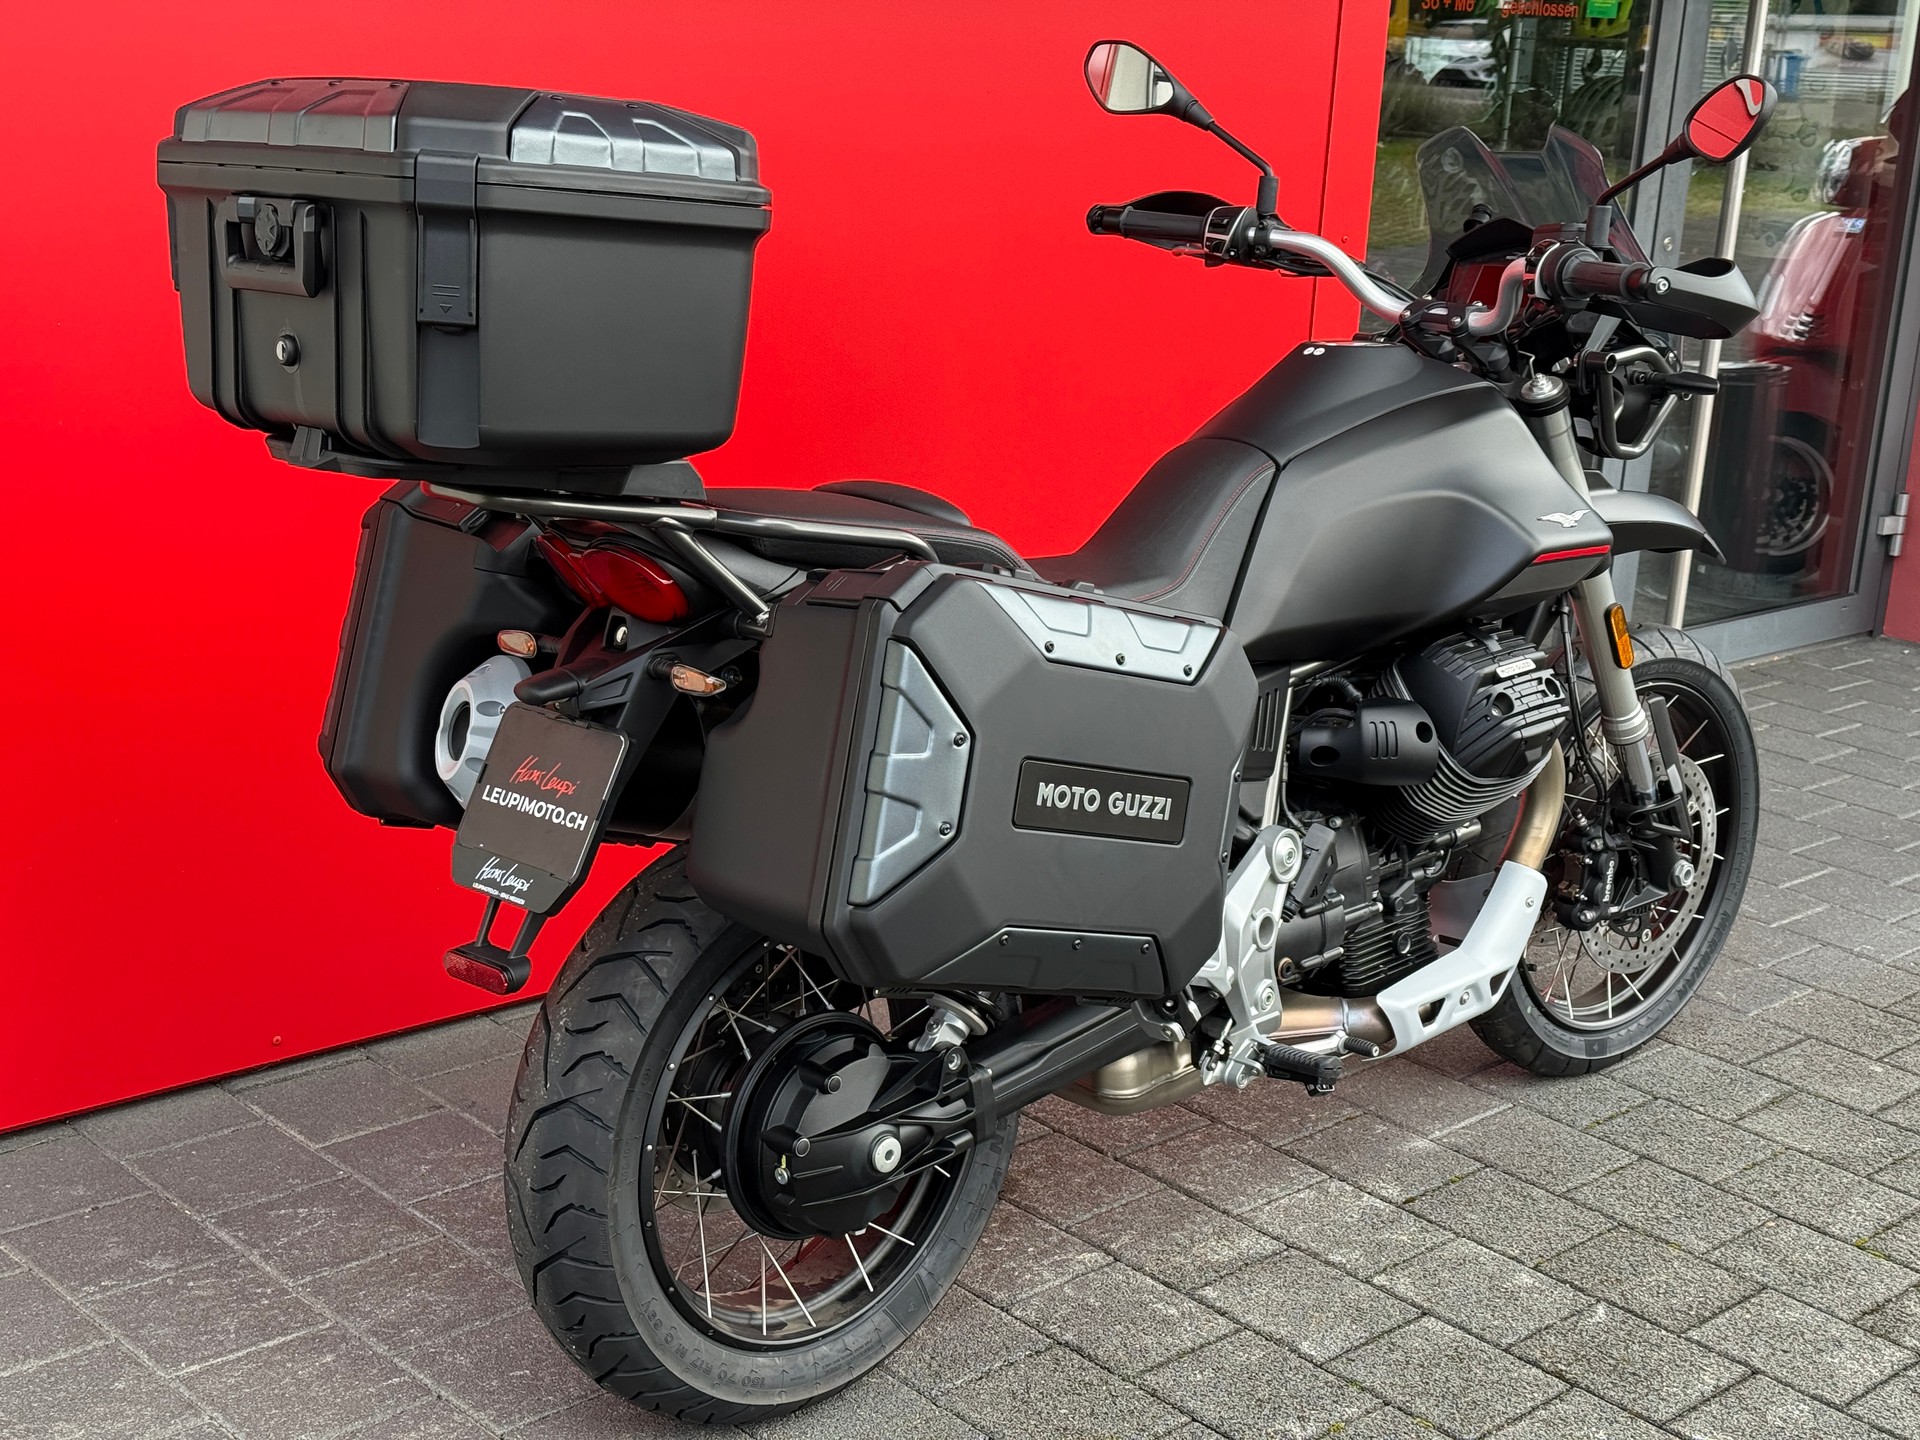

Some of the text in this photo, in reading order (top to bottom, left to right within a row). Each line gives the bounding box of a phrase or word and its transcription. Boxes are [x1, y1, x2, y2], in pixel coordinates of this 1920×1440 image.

[1501, 0, 1579, 18] geschlossen
[509, 755, 580, 799] Hans Leupi
[481, 785, 588, 831] LEUPIMOTO.CH
[1036, 781, 1172, 821] MOTO GUZZI
[475, 856, 534, 894] Hans Leupi
[1602, 860, 1615, 902] brembo
